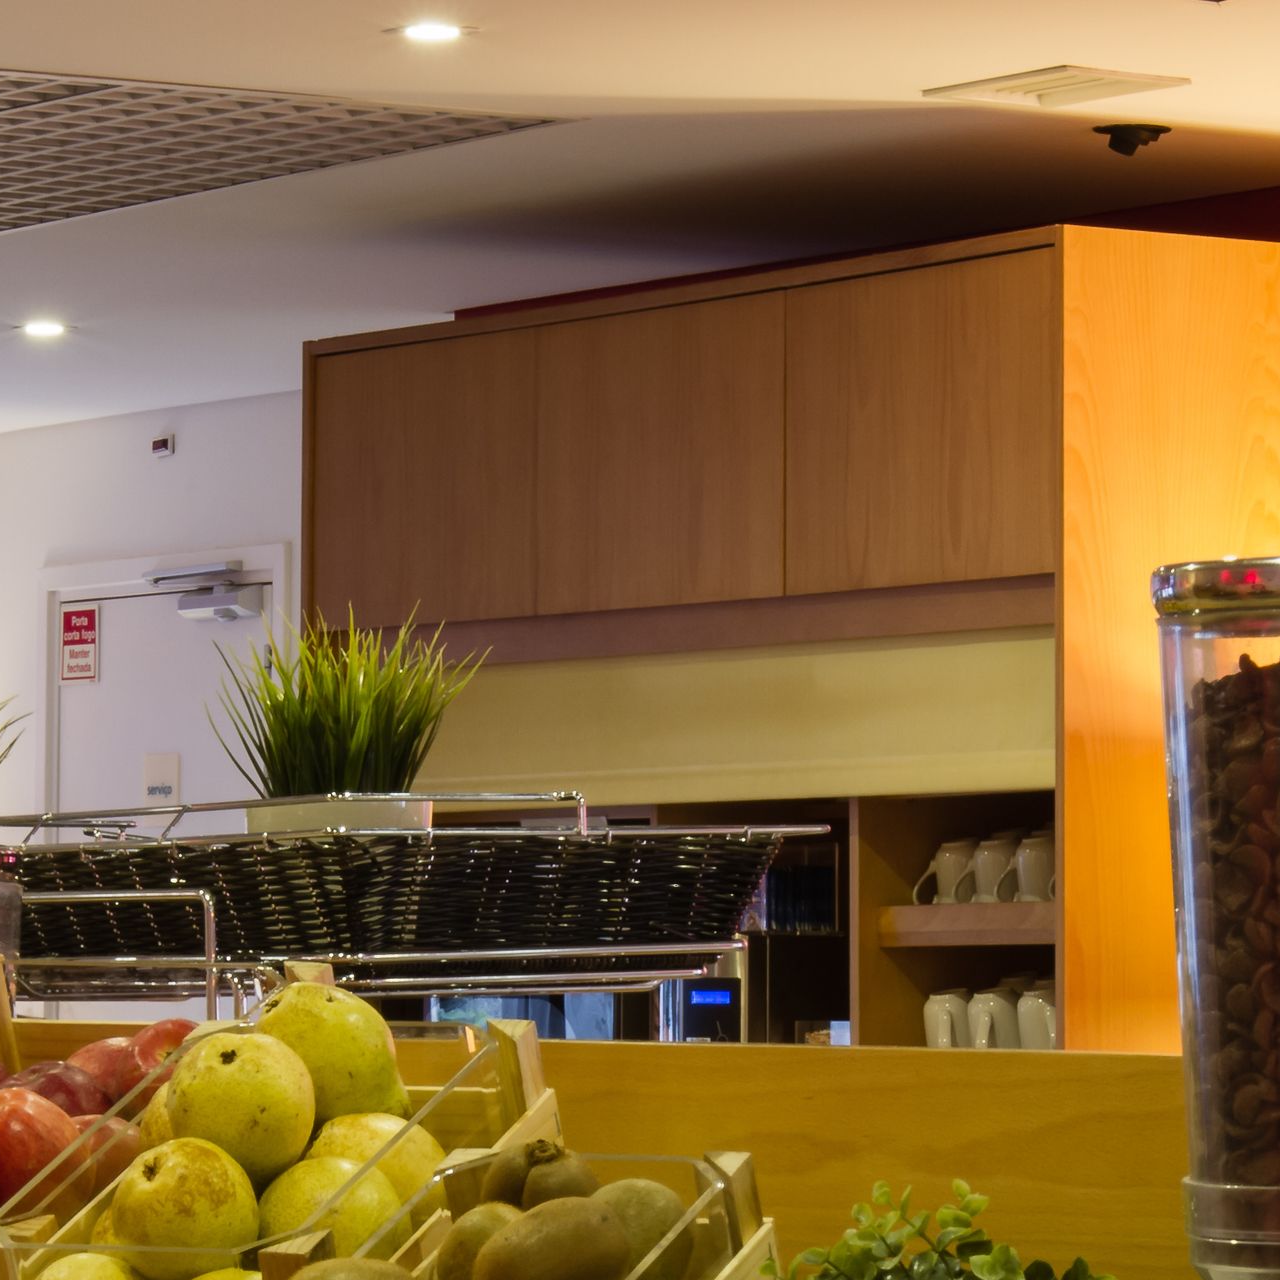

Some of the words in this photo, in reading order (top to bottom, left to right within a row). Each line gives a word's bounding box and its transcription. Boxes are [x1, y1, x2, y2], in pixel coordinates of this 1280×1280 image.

[71, 616, 88, 626] Porta
[64, 631, 80, 641] corta
[69, 648, 90, 659] Manter
[67, 663, 91, 673] fechada
[147, 783, 172, 798] serviço
